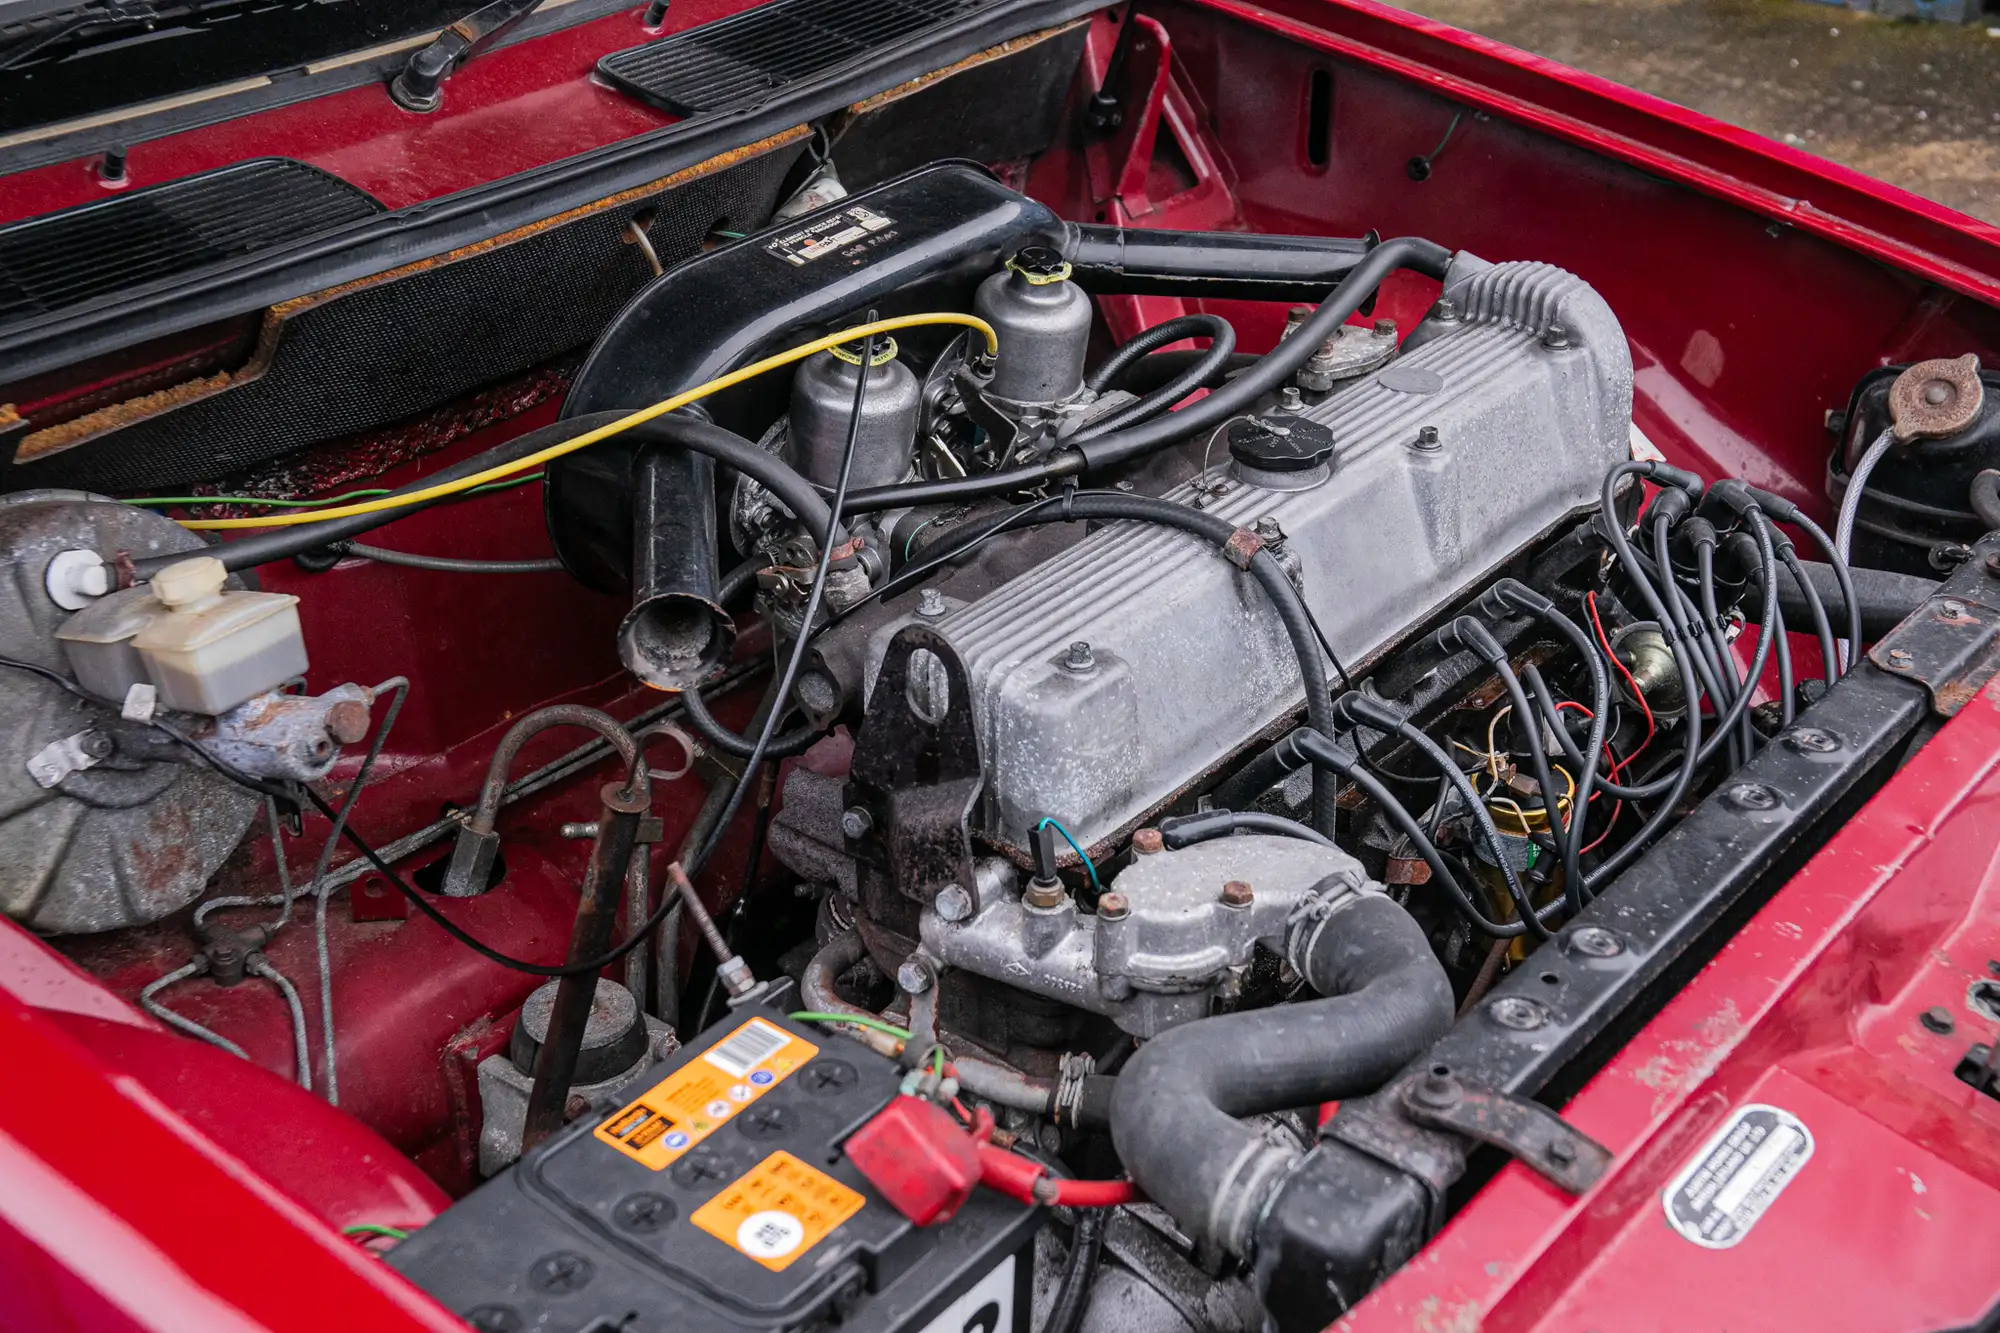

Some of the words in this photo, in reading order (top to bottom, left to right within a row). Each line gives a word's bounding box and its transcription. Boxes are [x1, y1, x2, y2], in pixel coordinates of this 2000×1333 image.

[1588, 742, 1597, 758] HIGH
[1476, 807, 1494, 836] DOUBLE
[1491, 838, 1514, 885] TEMPERATURE
